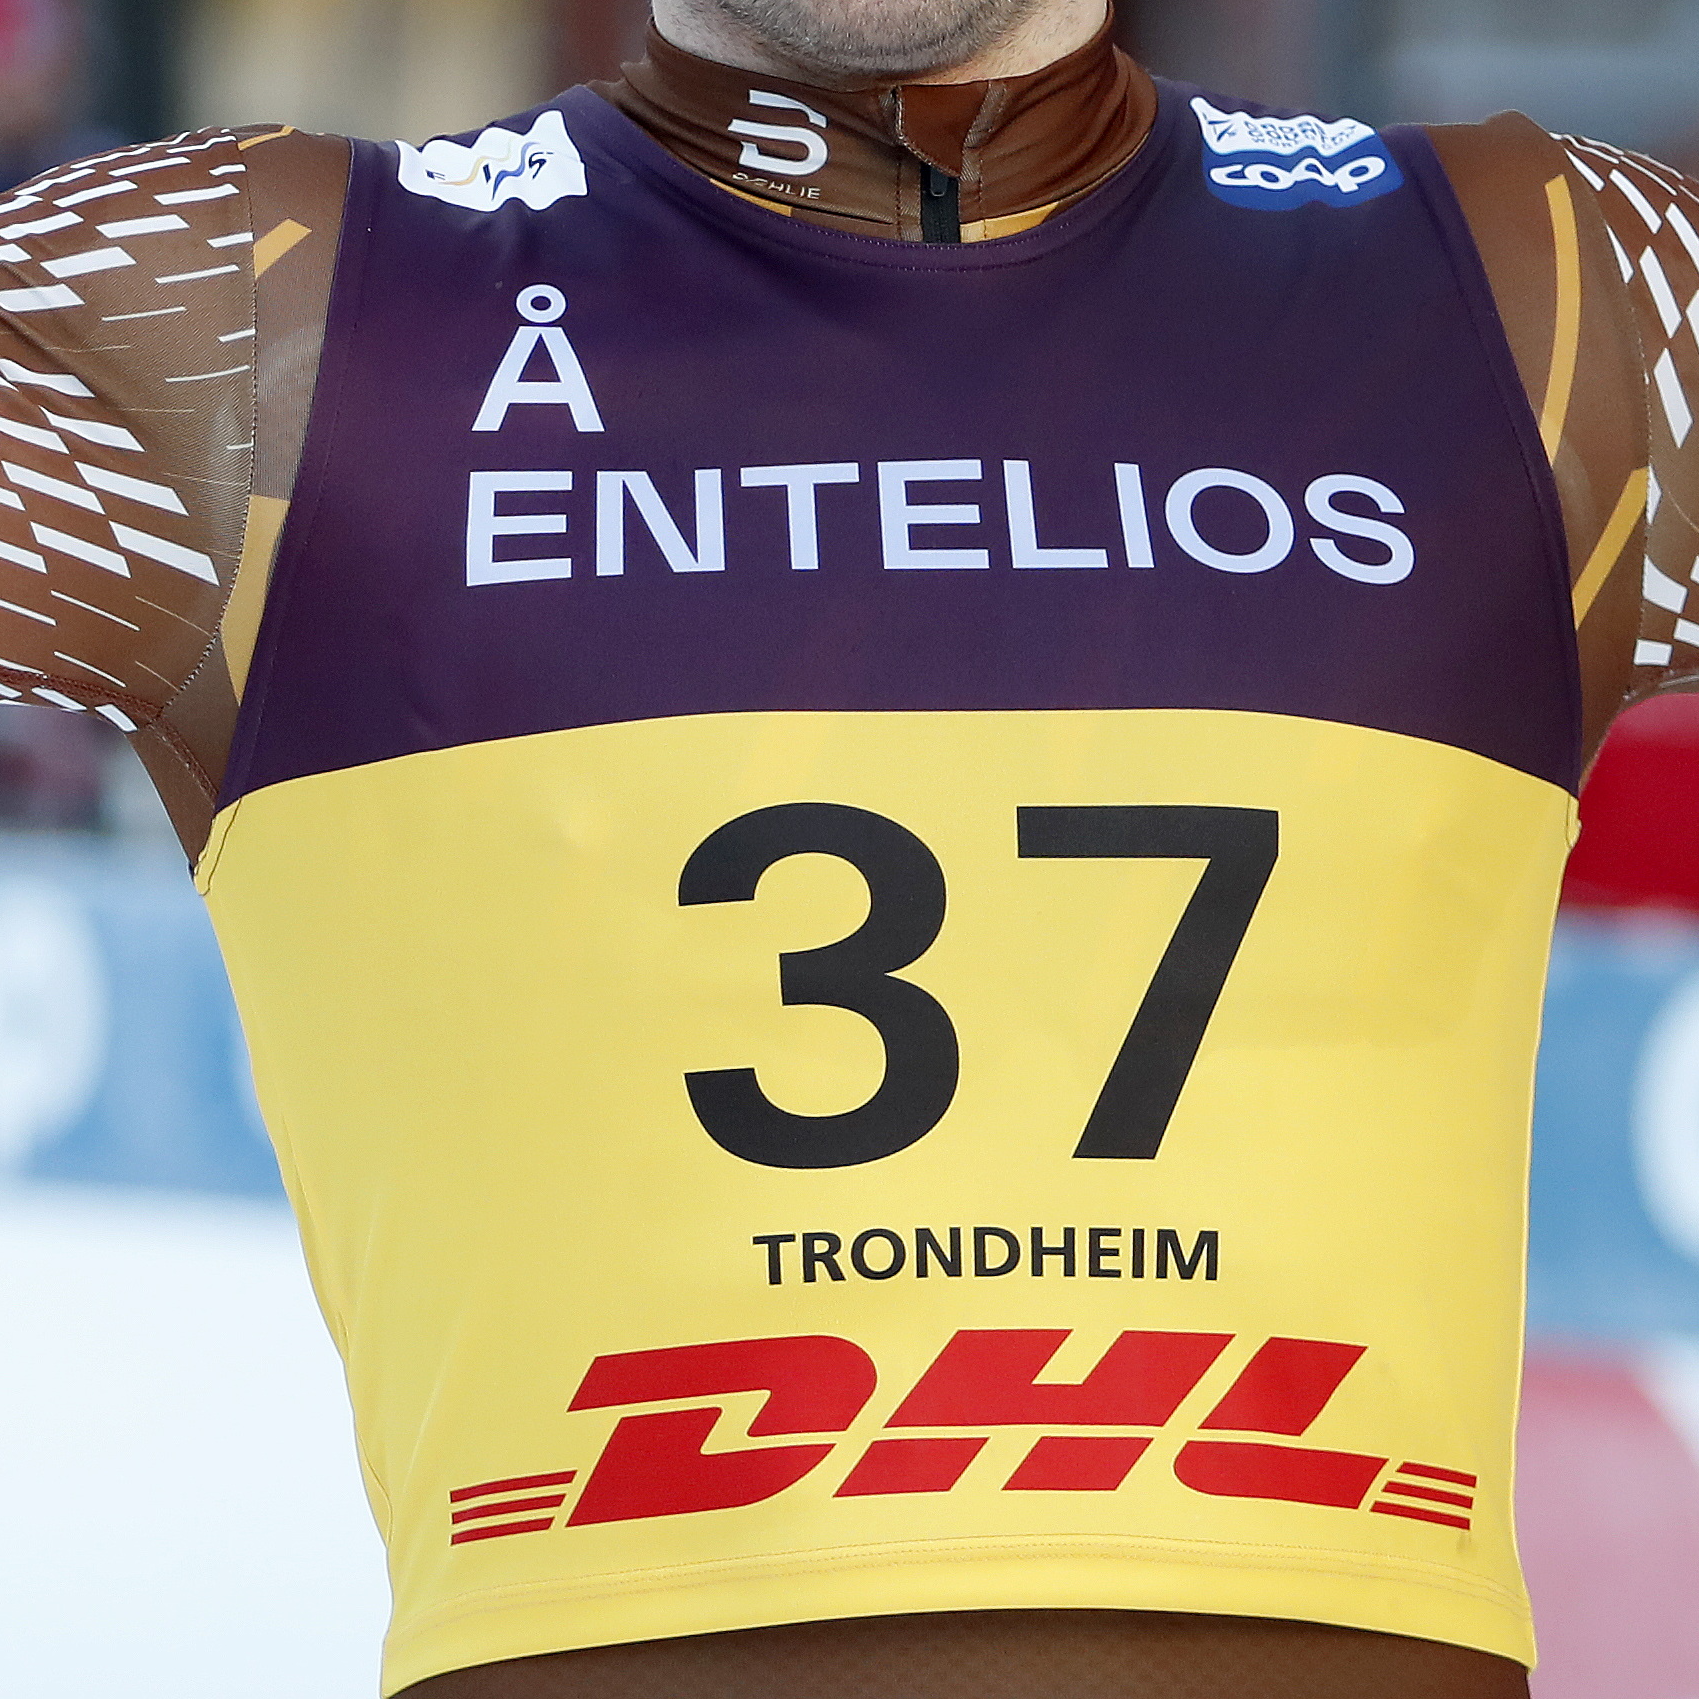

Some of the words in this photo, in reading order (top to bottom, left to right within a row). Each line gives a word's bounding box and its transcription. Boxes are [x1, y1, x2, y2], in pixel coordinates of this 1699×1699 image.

[471, 283, 606, 433] Å
[466, 458, 1416, 588] ENTELIOS
[678, 801, 1279, 1170] 37
[753, 1226, 1221, 1286] TRONDHEIM
[565, 1328, 1389, 1529] DHL
